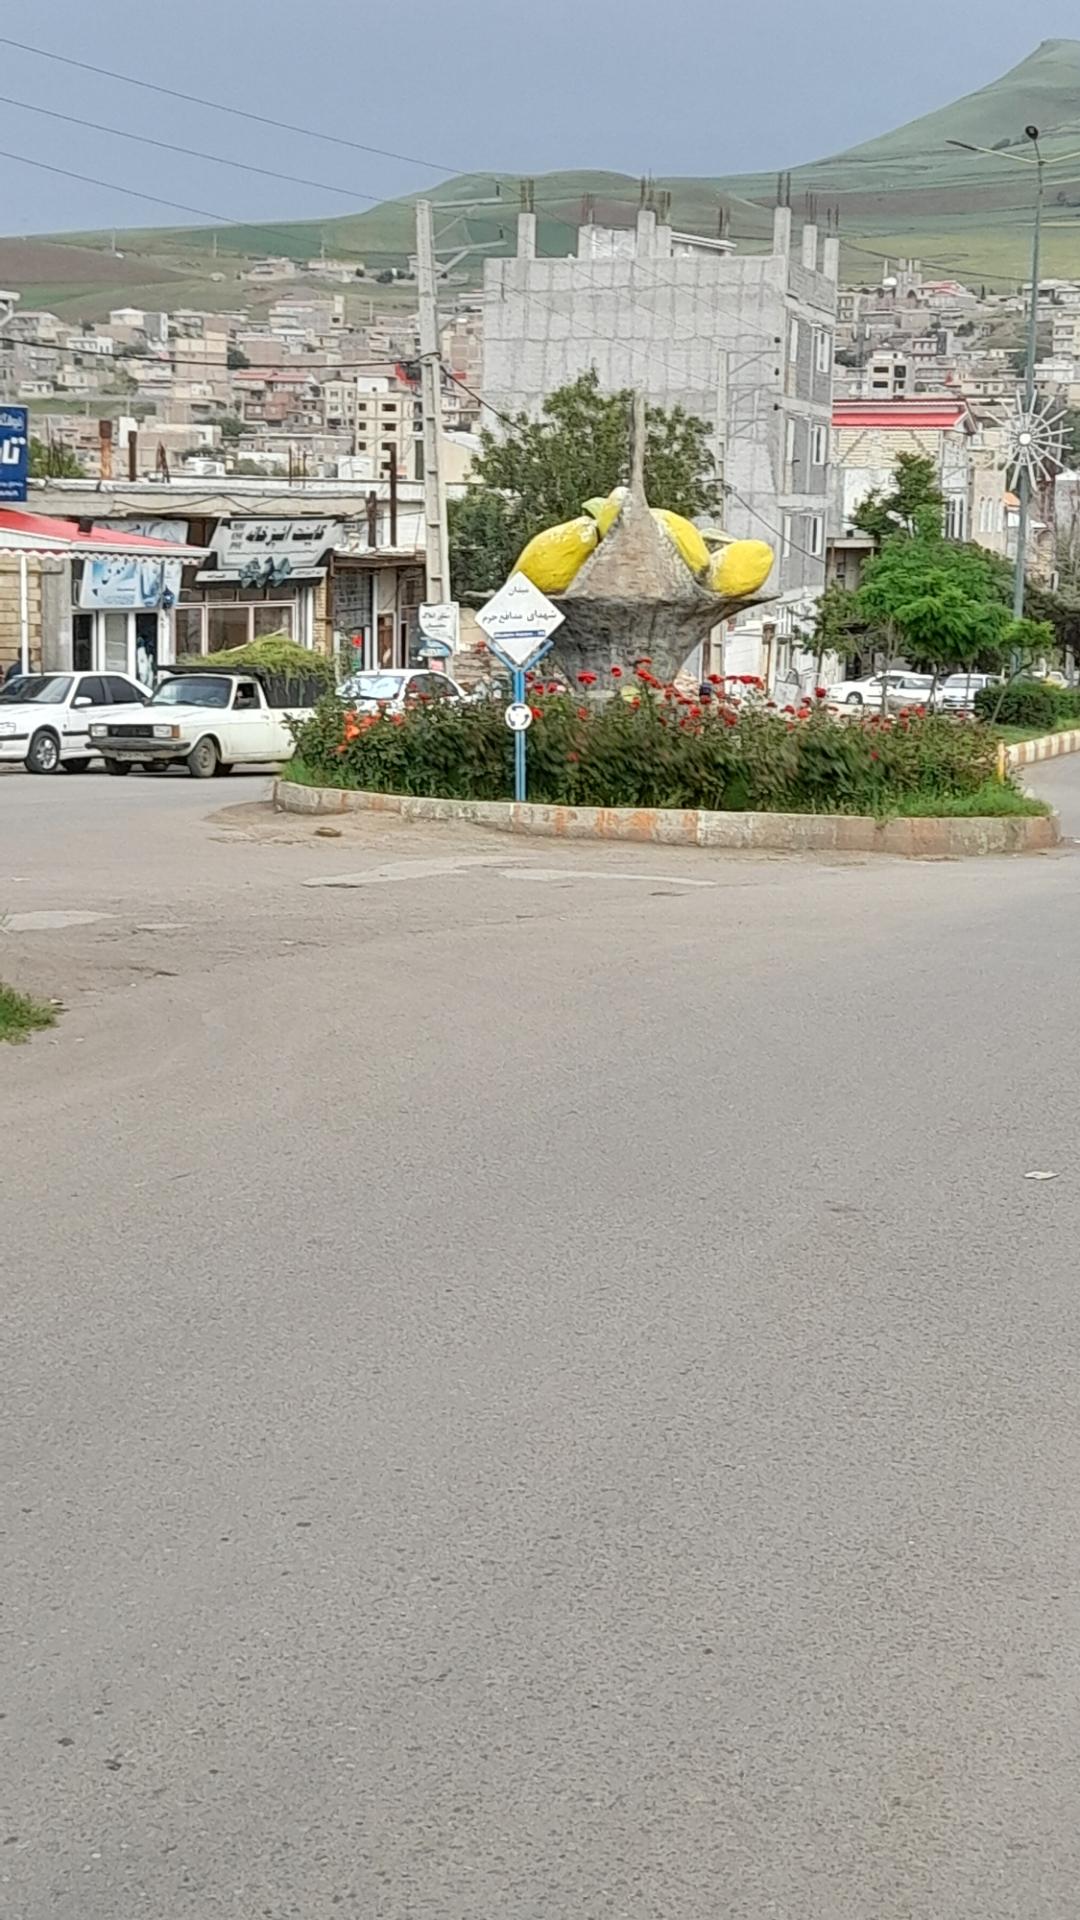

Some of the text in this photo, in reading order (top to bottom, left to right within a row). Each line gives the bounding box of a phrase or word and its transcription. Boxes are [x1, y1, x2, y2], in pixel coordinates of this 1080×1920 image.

[482, 609, 557, 624] شهدای مدافع حرم
